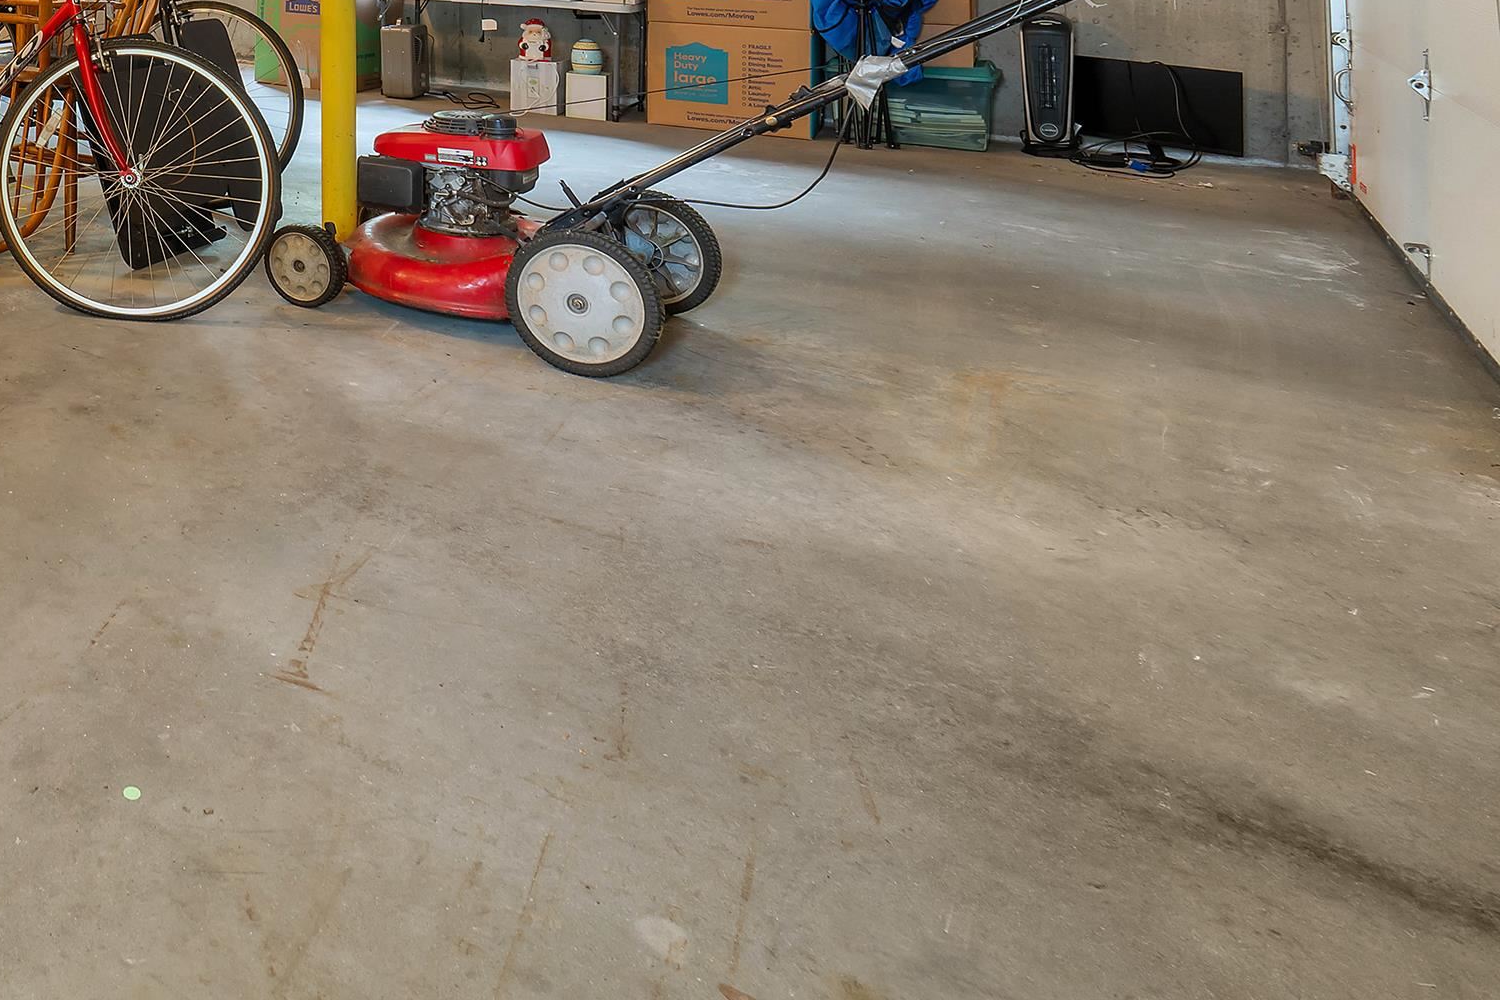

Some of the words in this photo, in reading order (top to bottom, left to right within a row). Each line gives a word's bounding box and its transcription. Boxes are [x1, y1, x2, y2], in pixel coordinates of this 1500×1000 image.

[289, 1, 319, 13] LOWE'S
[687, 10, 755, 20] Lowes.com/Moving
[674, 52, 708, 63] Heavy
[674, 61, 698, 71] Duty
[674, 71, 717, 87] large
